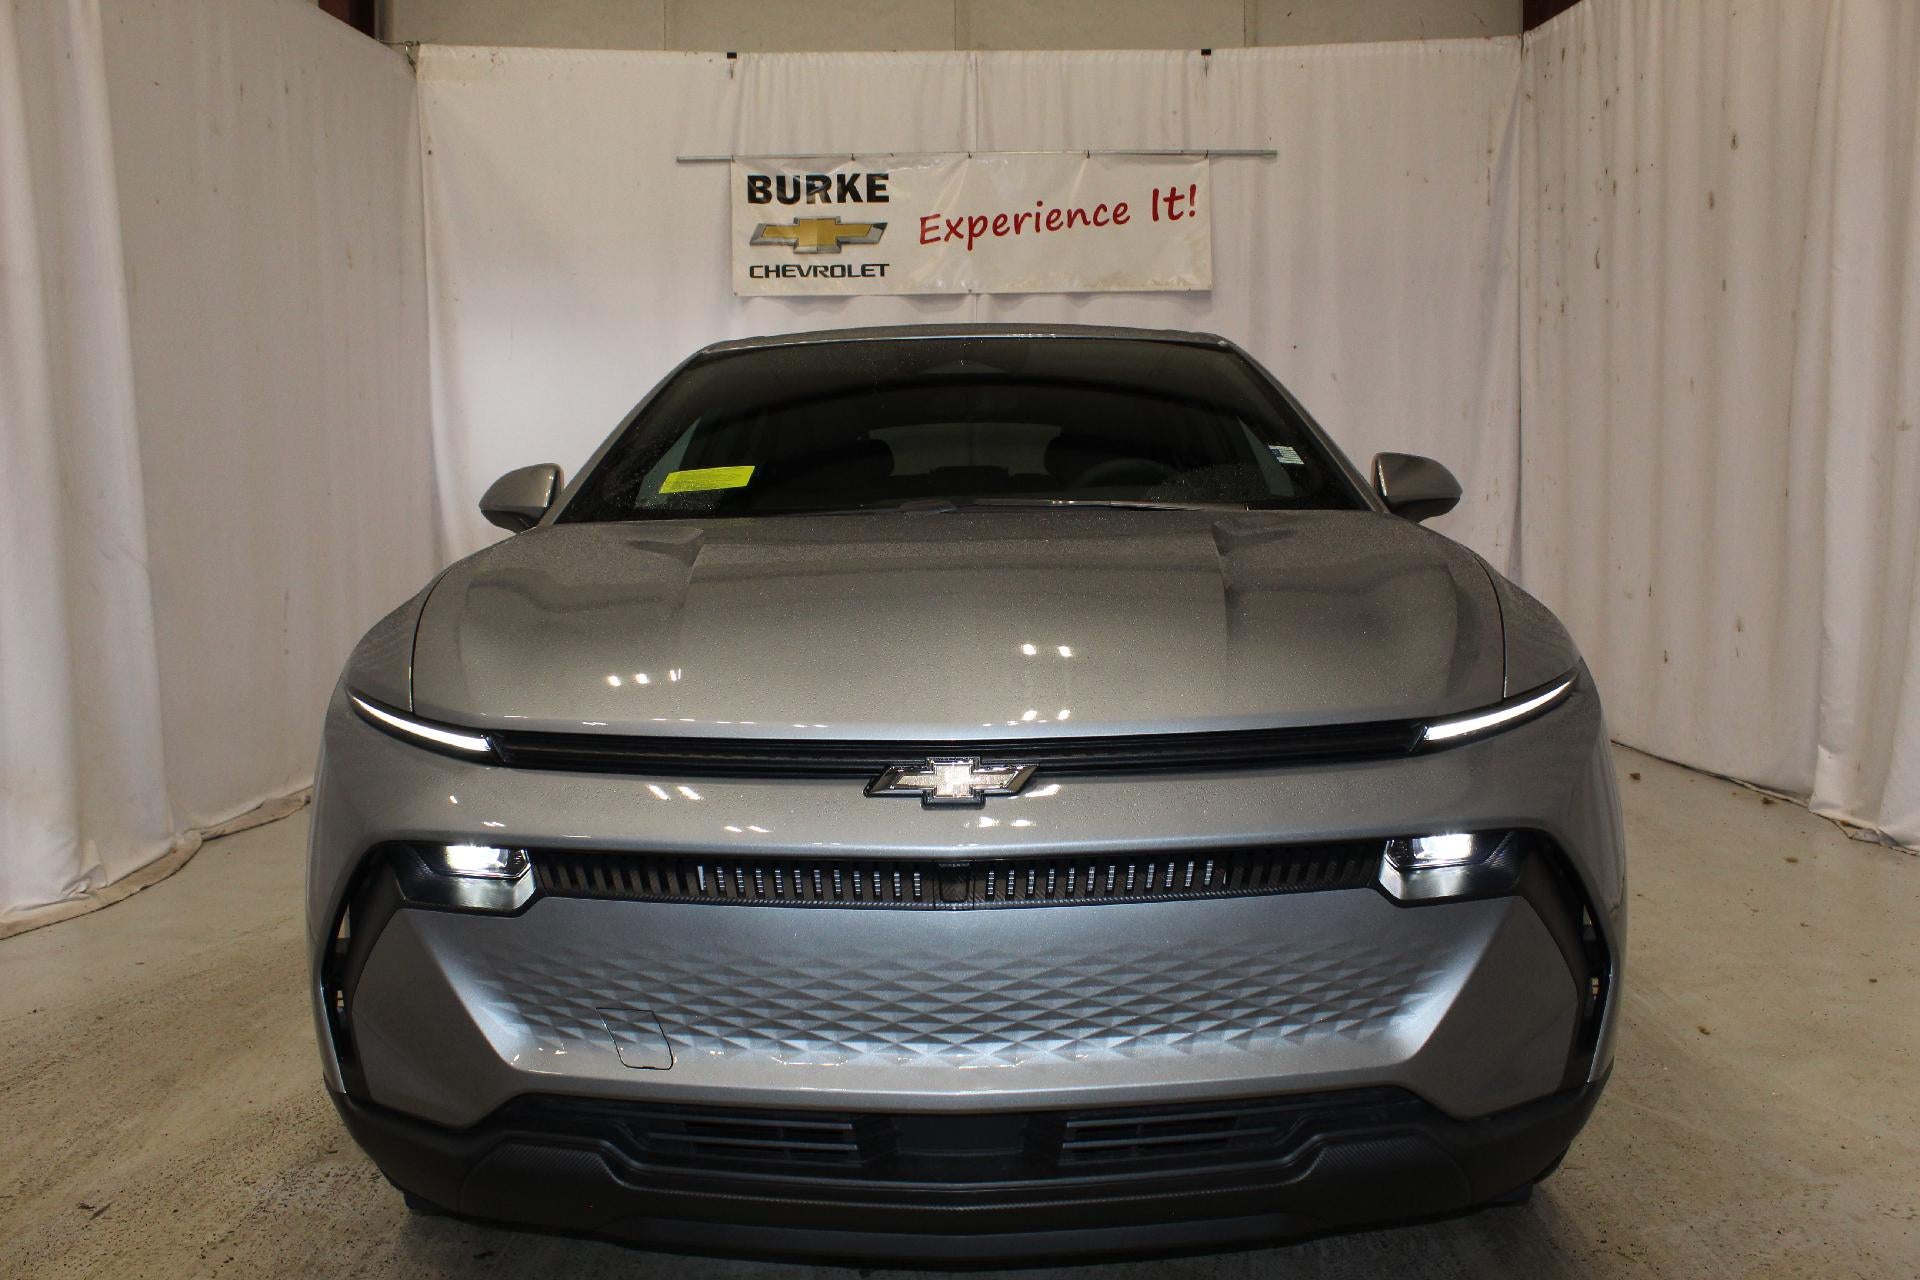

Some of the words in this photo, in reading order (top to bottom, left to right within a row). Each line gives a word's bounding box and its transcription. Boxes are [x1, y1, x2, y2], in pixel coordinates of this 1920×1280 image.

[747, 173, 890, 204] BURKE
[918, 200, 1130, 250] Experience
[1152, 184, 1198, 223] It!
[749, 263, 890, 279] CHEVROLET
